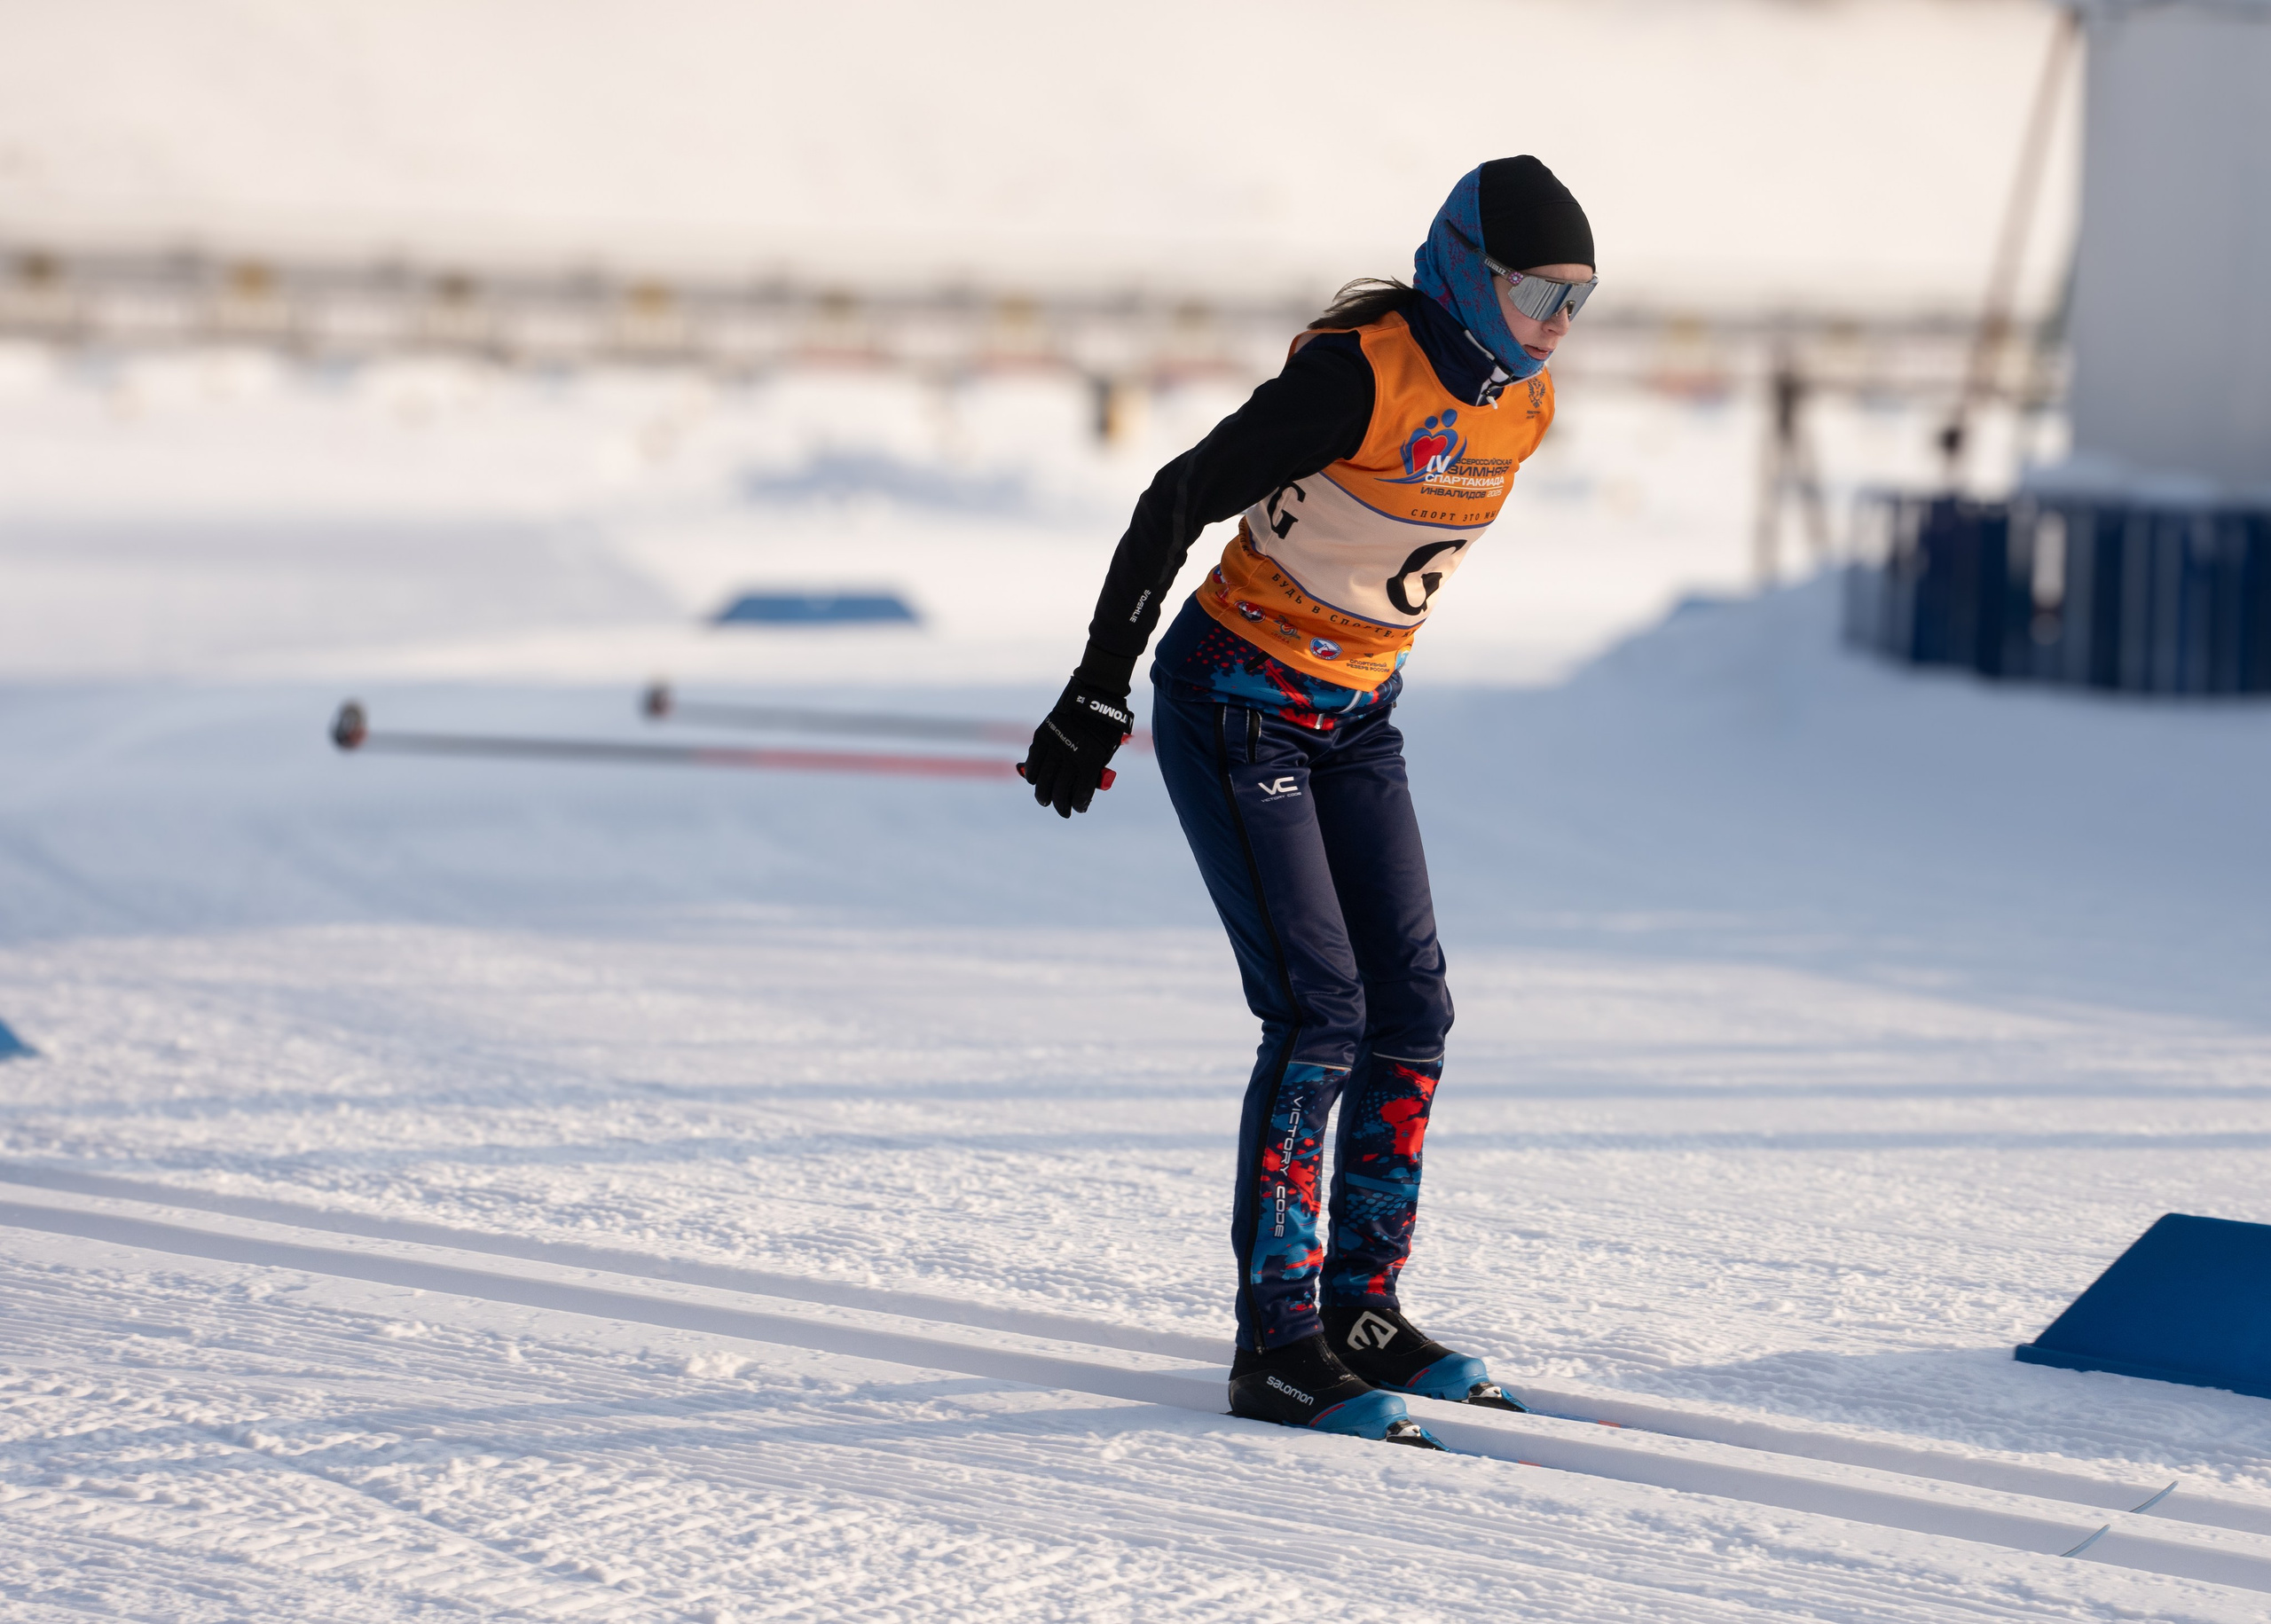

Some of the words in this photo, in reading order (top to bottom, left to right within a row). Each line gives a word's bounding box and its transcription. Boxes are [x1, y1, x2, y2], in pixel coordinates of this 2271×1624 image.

[1426, 455, 1451, 474] IV
[1447, 465, 1510, 477] ЗИМНЯЯ
[1425, 474, 1505, 487] СПАРТАКИАДА
[1420, 487, 1487, 500] ИНВАЛИДОВ
[1267, 482, 1306, 540] G
[1411, 508, 1456, 521] СПОРТ
[1462, 513, 1481, 522] ЭТО
[1386, 538, 1468, 616] G
[1271, 573, 1302, 605] БУДЬ
[1311, 605, 1321, 614] В
[1088, 700, 1134, 731] TOMIC
[1257, 776, 1299, 796] VC
[1261, 794, 1285, 803] VICTORY
[1279, 1095, 1304, 1177] VICTORY
[1274, 1185, 1286, 1239] CODE
